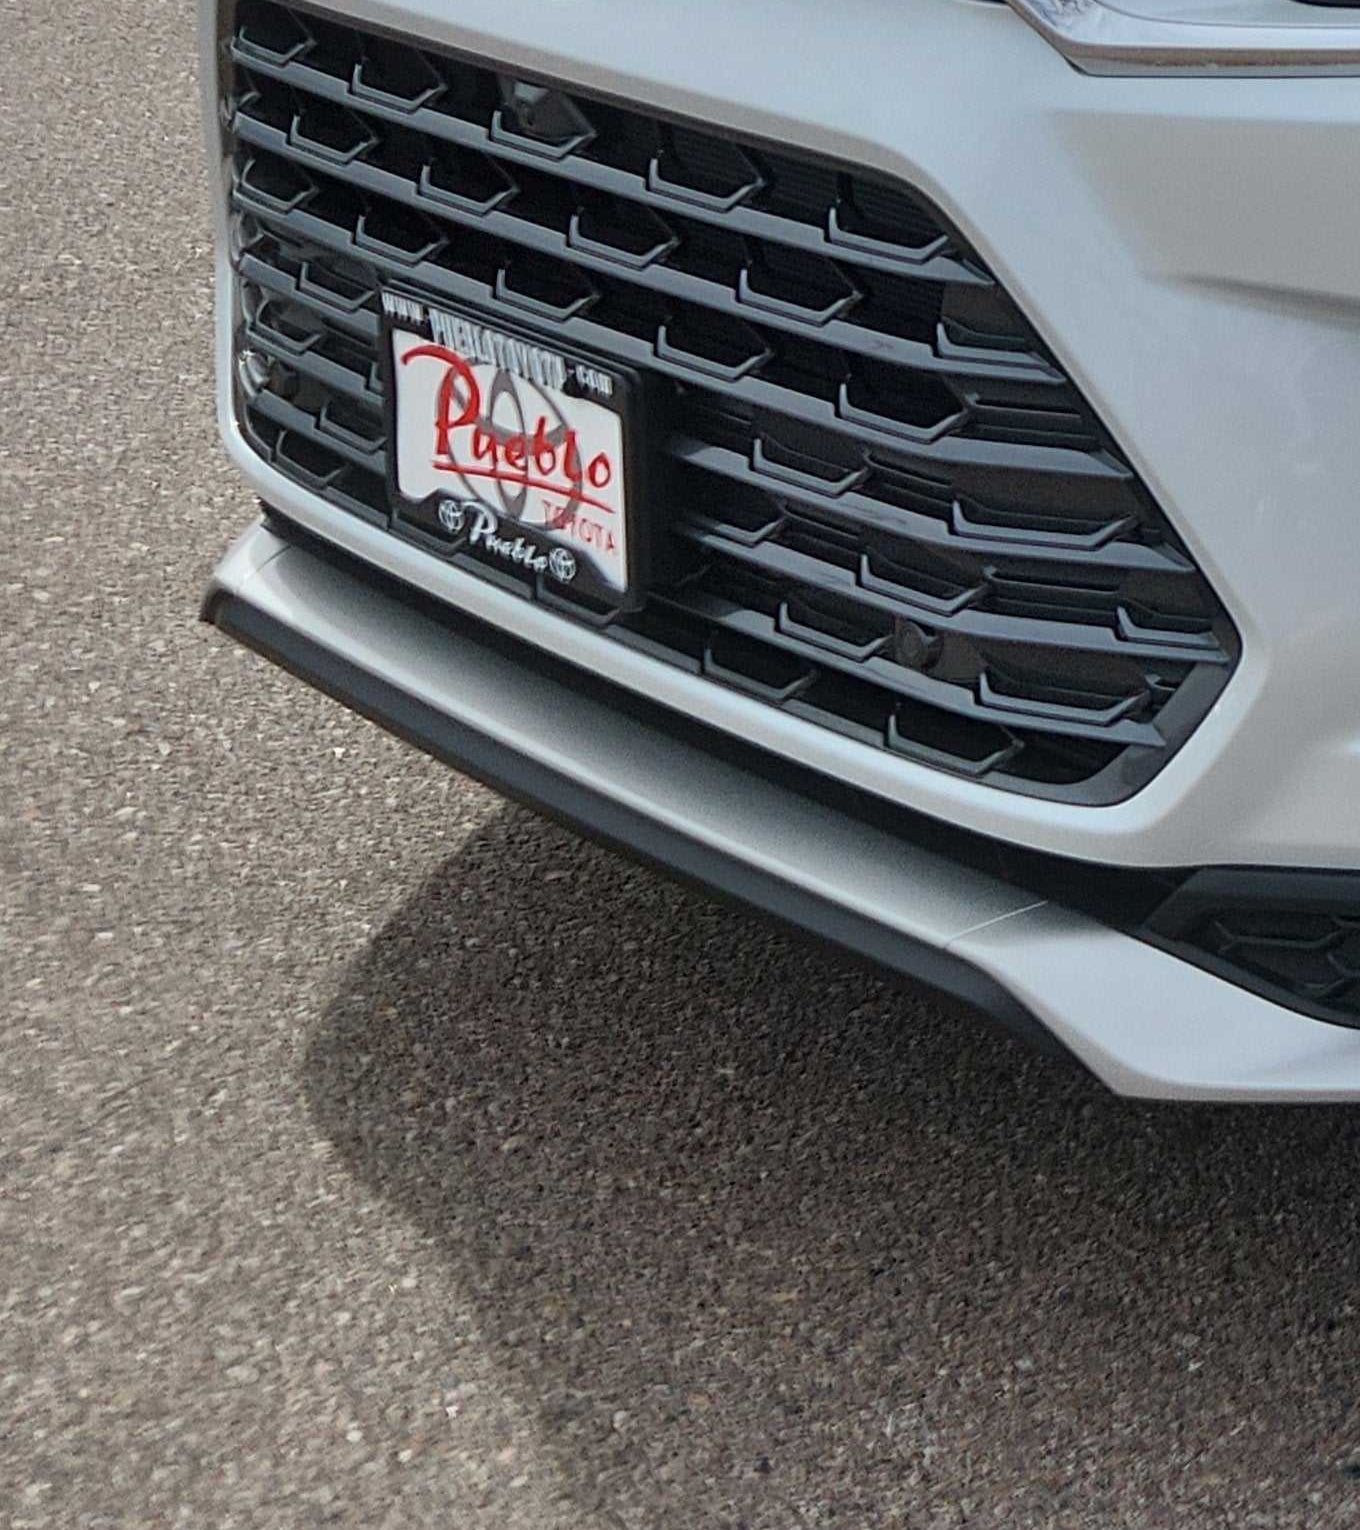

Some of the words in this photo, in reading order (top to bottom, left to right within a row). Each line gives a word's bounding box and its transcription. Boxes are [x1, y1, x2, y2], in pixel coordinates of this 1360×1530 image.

[400, 344, 611, 488] Pueblo
[461, 500, 549, 574] Pueblo
[542, 499, 616, 553] TOYOTA
